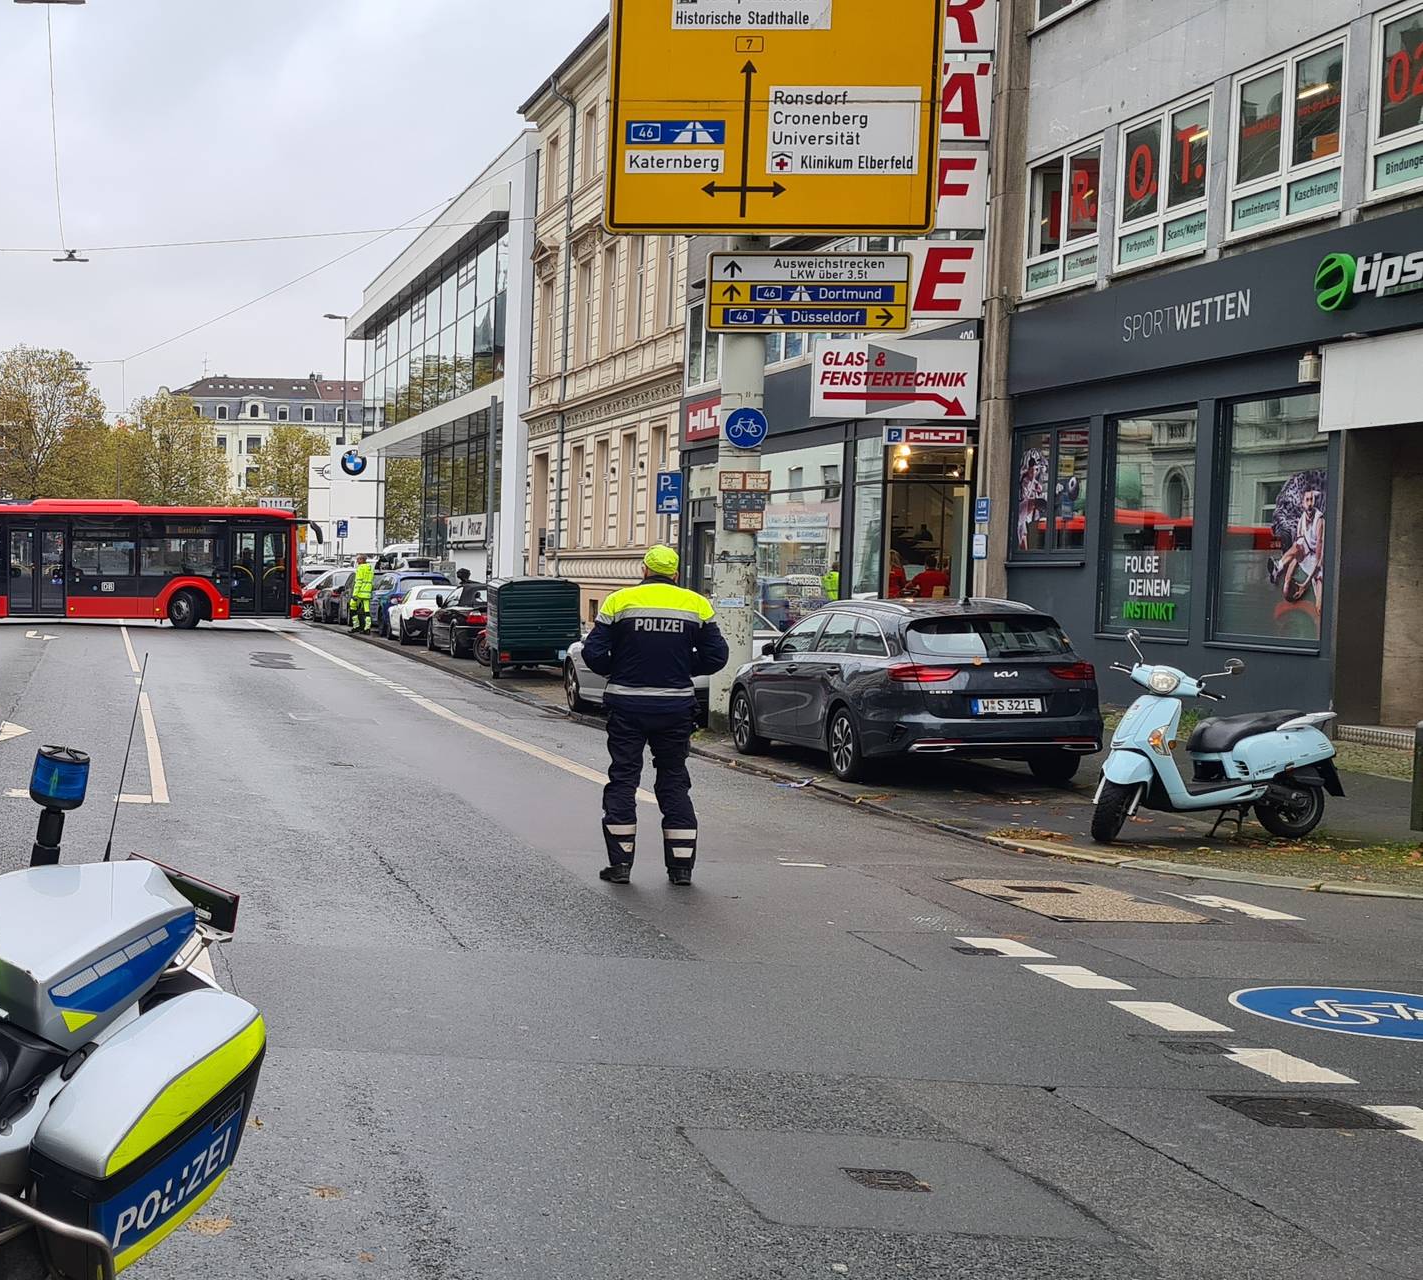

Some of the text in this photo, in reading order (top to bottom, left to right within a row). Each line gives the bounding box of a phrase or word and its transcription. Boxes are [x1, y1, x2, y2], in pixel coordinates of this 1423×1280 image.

[675, 11, 810, 25] Historische Stadthalle
[746, 39, 754, 50] 7
[773, 90, 848, 105] Ronsdorf
[772, 111, 869, 128] Cronenberg
[638, 127, 654, 138] 46
[772, 130, 861, 145] Universität
[628, 154, 720, 172] Katernberg
[800, 155, 913, 170] Klinikum Elberfeld
[1294, 181, 1338, 202] Kaschierung
[1238, 199, 1280, 220] Laminierung
[1126, 234, 1155, 254] Farbproofs
[773, 257, 885, 269] Ausweichstrecken
[790, 269, 816, 280] LKW
[819, 269, 844, 280] über
[763, 287, 882, 300] 46 Dortmund
[735, 310, 861, 323] 46 Düsseldorf
[1122, 288, 1252, 343] SPORTWETTEN
[822, 351, 886, 367] GLAS- &
[819, 371, 968, 388] FENSTERTECHNIK
[908, 431, 961, 441] HILTI
[1124, 555, 1160, 574] FOLGE
[103, 583, 114, 591] DB
[1128, 578, 1171, 598] DEINEM
[1122, 600, 1176, 621] INSTINKT
[634, 618, 684, 633] POLIZEI
[982, 700, 1037, 711] W S 321E
[112, 1127, 232, 1249] POLIZEI
